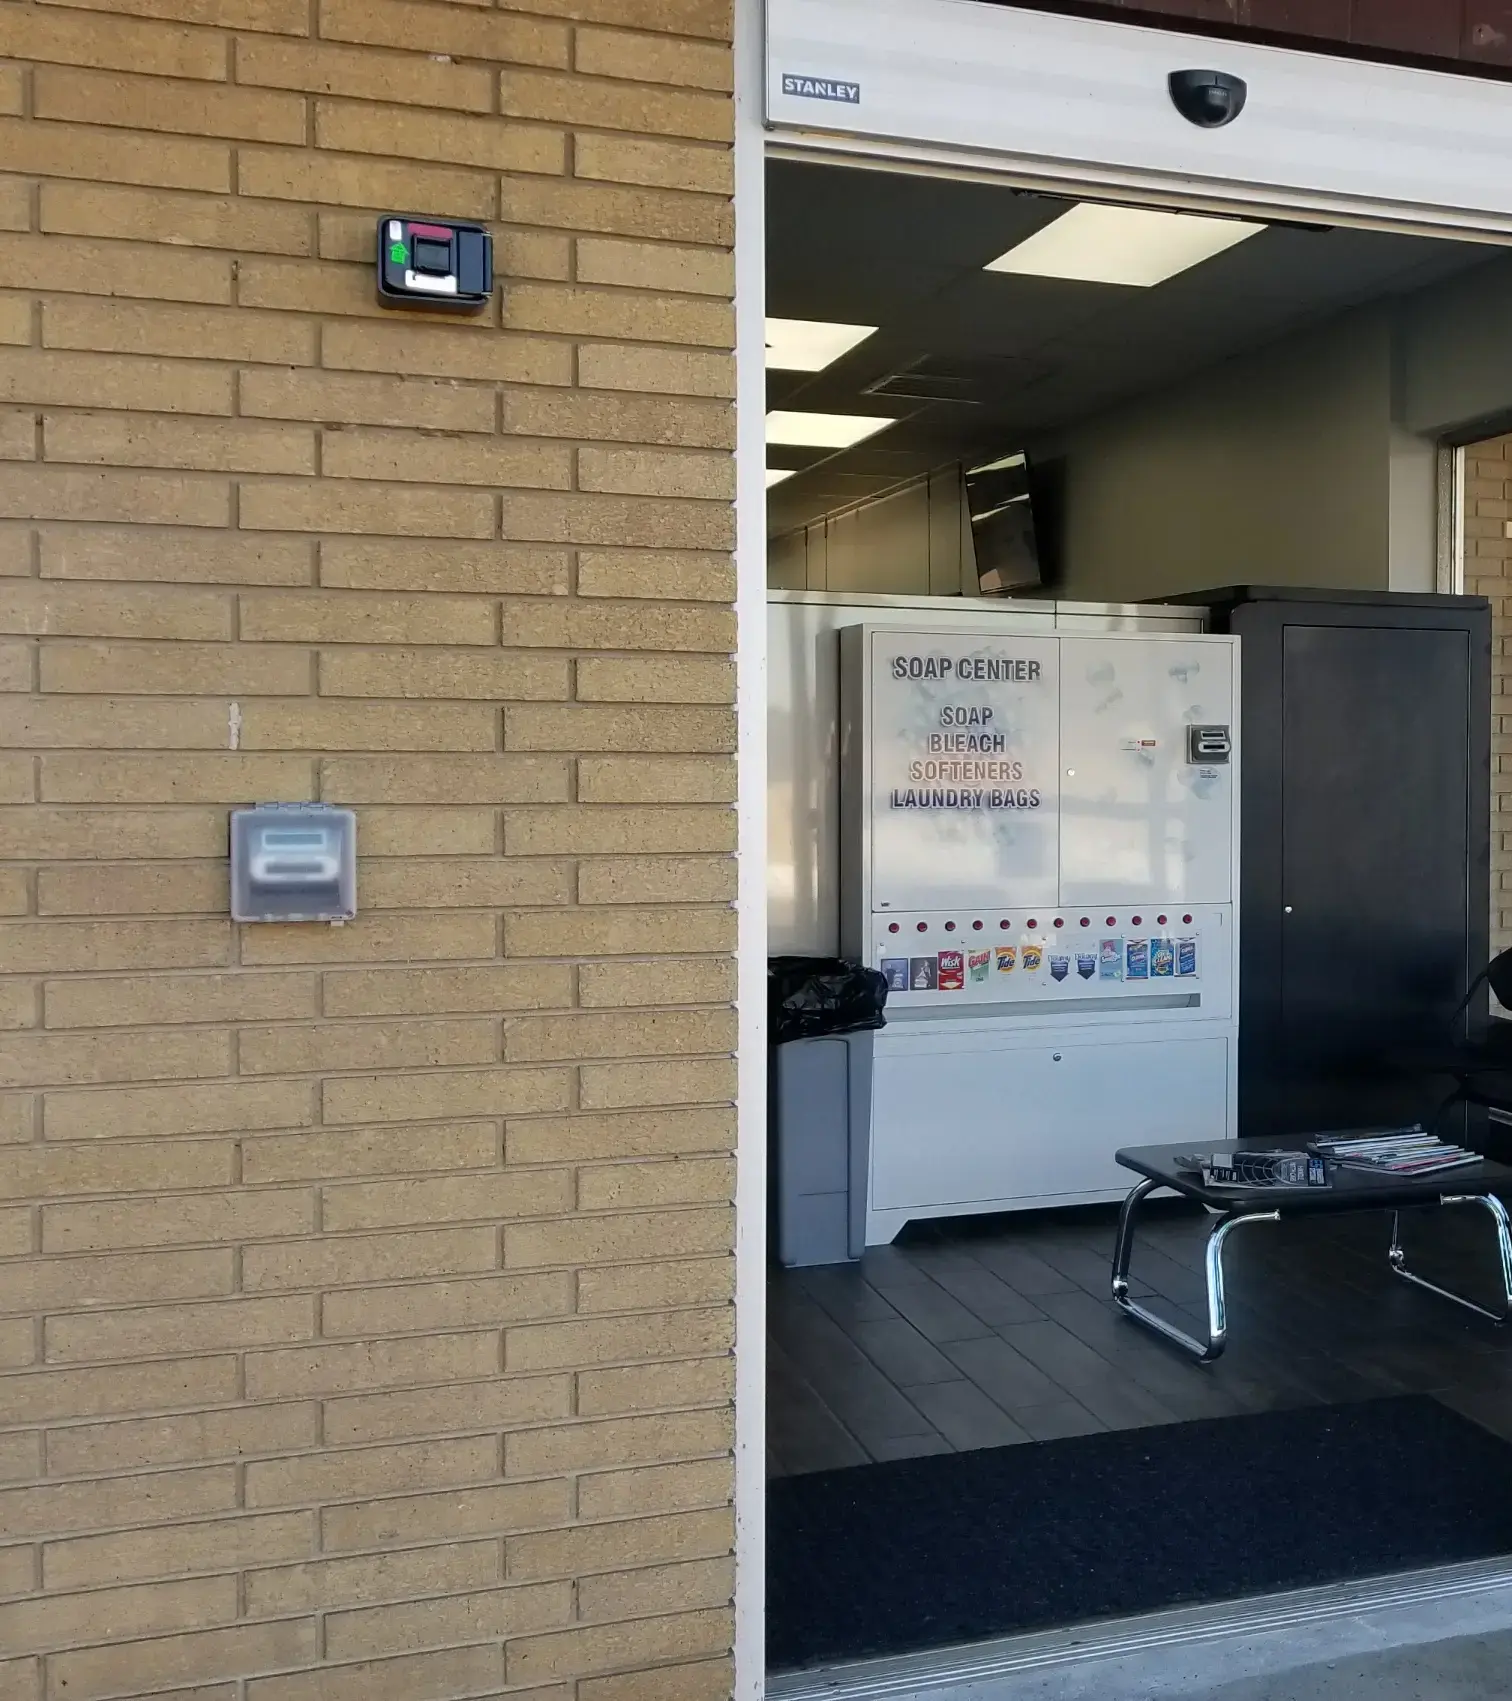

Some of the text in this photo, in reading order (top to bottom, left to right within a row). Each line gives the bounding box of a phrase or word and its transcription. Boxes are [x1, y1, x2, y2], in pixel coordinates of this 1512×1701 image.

[785, 78, 857, 98] STANLEY
[894, 656, 1041, 681] SOAP CENTER
[941, 706, 993, 726] SOAP
[929, 733, 1005, 753] BLEACH
[911, 760, 1023, 781] SOFTENERS
[893, 788, 1042, 808] LAUNDRY BAGS
[997, 955, 1015, 971] Tide
[1023, 954, 1041, 970] Tide
